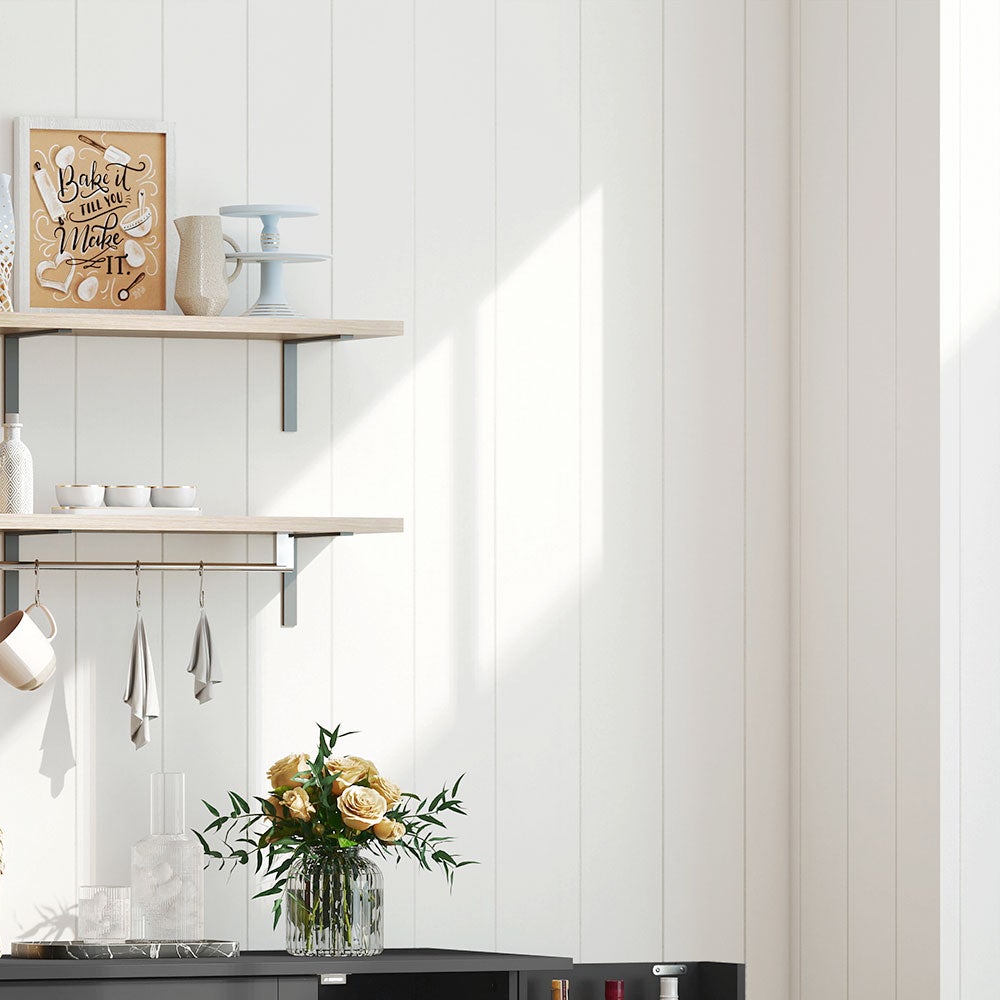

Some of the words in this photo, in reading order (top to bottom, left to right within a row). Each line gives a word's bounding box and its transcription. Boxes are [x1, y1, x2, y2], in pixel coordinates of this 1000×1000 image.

[58, 161, 110, 203] Bake
[79, 199, 102, 216] TILL
[104, 192, 123, 208] YOU
[54, 213, 124, 254] Make
